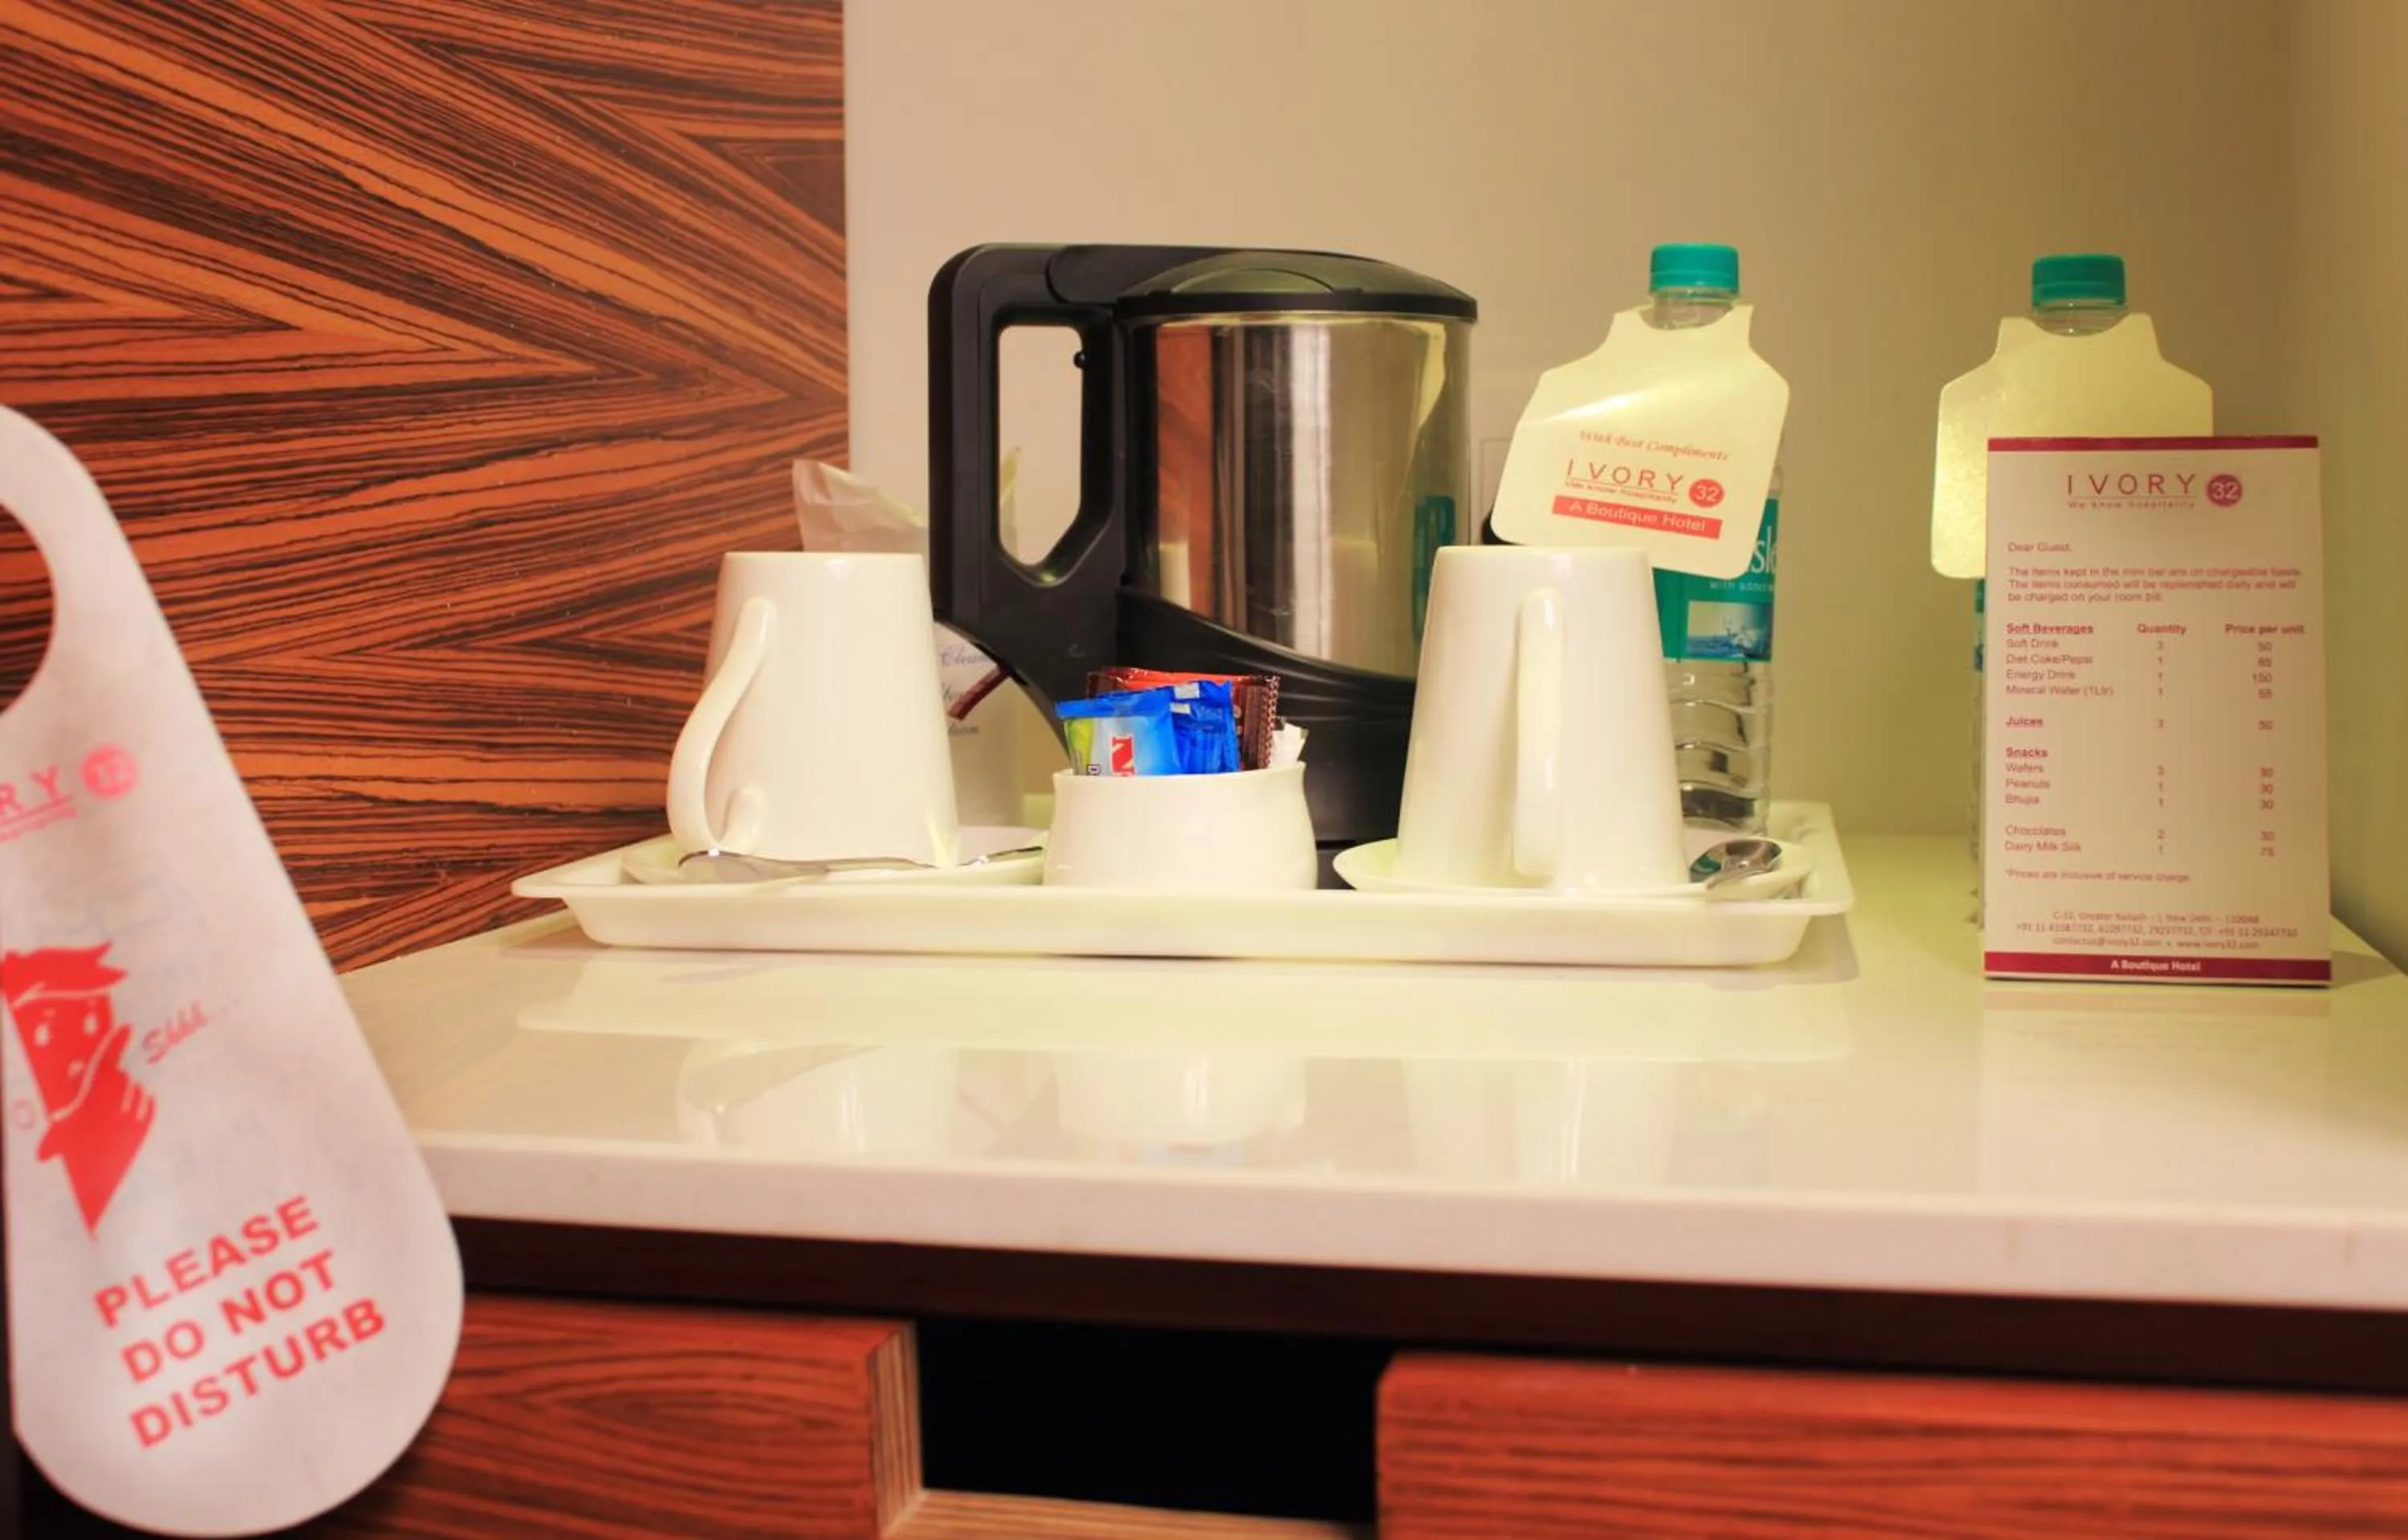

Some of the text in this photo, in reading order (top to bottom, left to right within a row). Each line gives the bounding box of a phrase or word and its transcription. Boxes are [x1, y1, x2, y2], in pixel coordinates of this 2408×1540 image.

[1567, 458, 1719, 503] IVORY 32
[2068, 474, 2239, 499] IVORY 32
[1568, 501, 1707, 532] A Boutique Hotel
[2007, 542, 2035, 552] Dear
[2010, 567, 2029, 576] The
[2031, 567, 2060, 576] items
[2064, 567, 2086, 579] kept
[2089, 567, 2100, 576] in
[2102, 567, 2120, 576] the
[2009, 580, 2029, 589] The
[2032, 580, 2061, 589] items
[2064, 580, 2120, 589] consumed
[2143, 580, 2157, 589] be
[2007, 593, 2022, 601] be
[2024, 593, 2069, 603] charged
[2071, 593, 2085, 601] on
[2089, 593, 2112, 604] your
[2006, 623, 2304, 636] Soft Beverages Quantity Price per unit
[2006, 638, 2029, 648] Soft
[2031, 638, 2059, 648] Drink
[2006, 654, 2028, 664] Diet
[2006, 669, 2044, 681] Energy
[2048, 669, 2076, 679] Drink
[2006, 685, 2046, 695] Mineral
[2049, 685, 2081, 695] Water
[2006, 716, 2044, 727] Juices
[2005, 747, 2049, 758] Snacks
[2005, 763, 2044, 773] Wafers
[2005, 778, 2050, 789] Peanuts
[2004, 825, 2066, 837] Chocolates
[2004, 841, 2033, 853] Dairy
[2036, 841, 2058, 851] Milk
[2105, 870, 2117, 880] of
[2110, 960, 2202, 972] A Boutique Hotel
[94, 1193, 319, 1328] PLEASE
[120, 1249, 334, 1383] DO NOT
[129, 1298, 386, 1448] DISTURB
